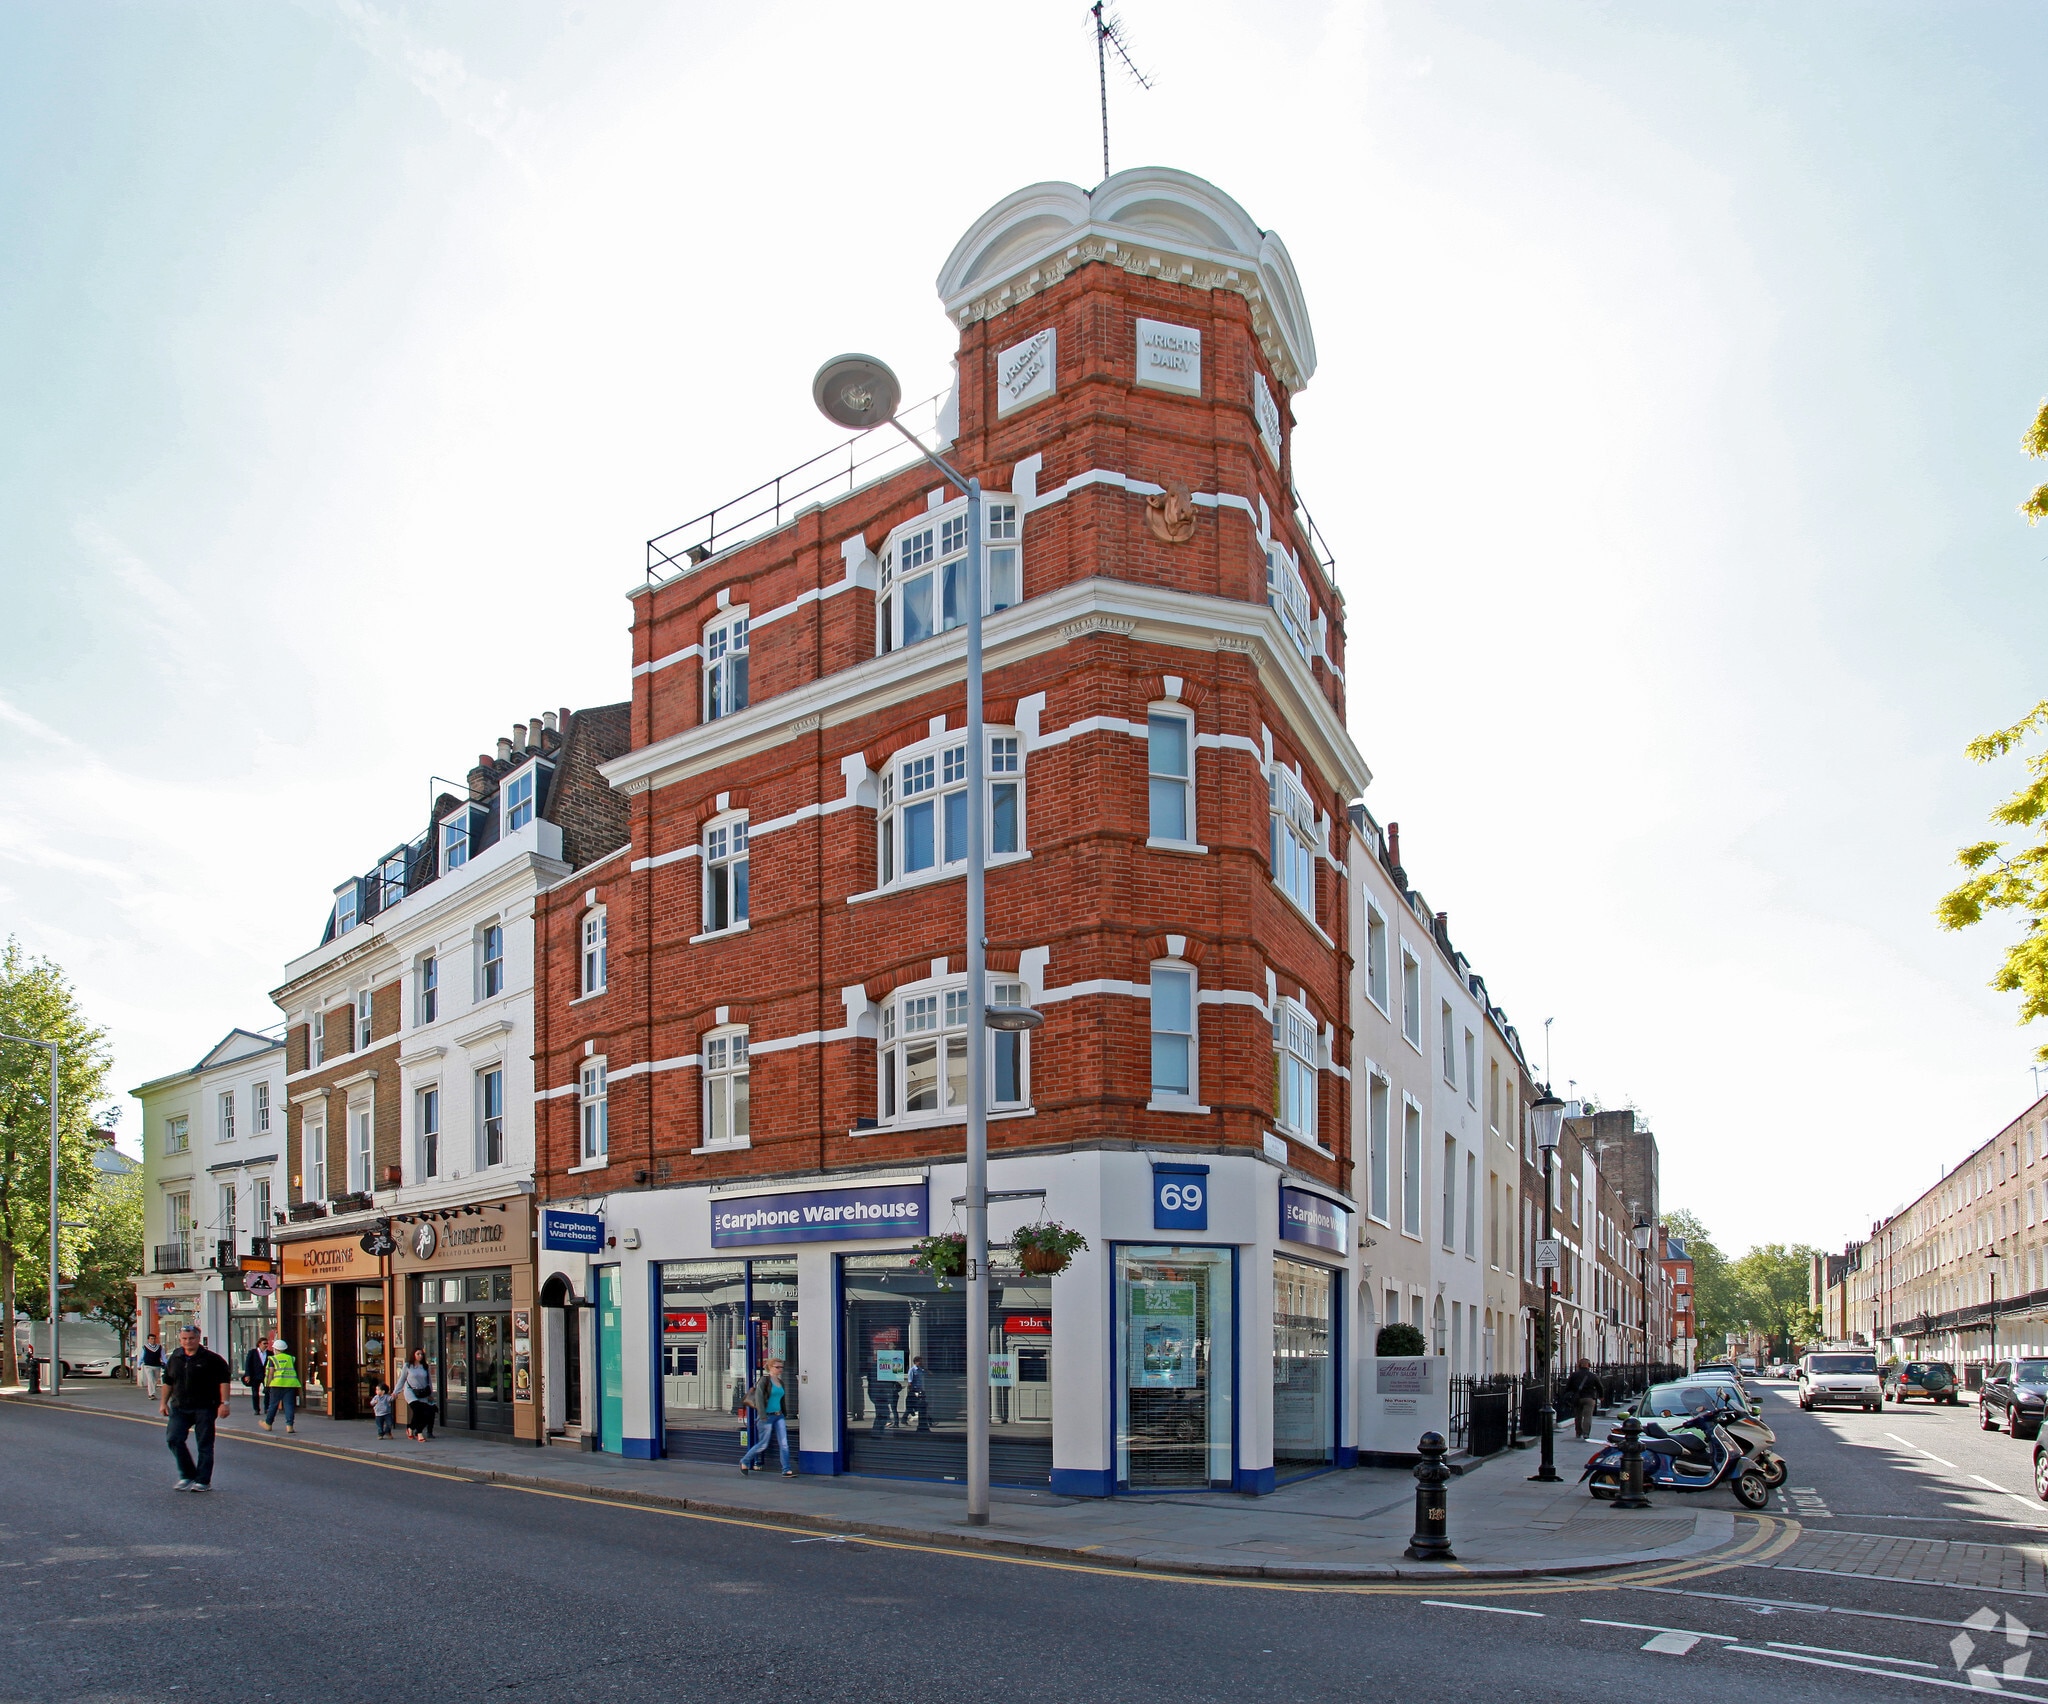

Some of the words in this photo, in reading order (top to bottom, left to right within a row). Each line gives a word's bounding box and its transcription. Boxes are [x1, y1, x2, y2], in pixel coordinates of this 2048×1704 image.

[1151, 352, 1191, 373] DAIRY
[1009, 355, 1044, 399] DAIRY
[1160, 1183, 1203, 1211] 69
[722, 1209, 800, 1230] Carphone
[803, 1201, 919, 1222] Warehouse
[1292, 1205, 1331, 1228] Carphone
[549, 1230, 597, 1240] Warehouse
[553, 1222, 597, 1232] Carphone
[472, 1245, 507, 1254] NATURALE
[769, 1282, 783, 1294] 69
